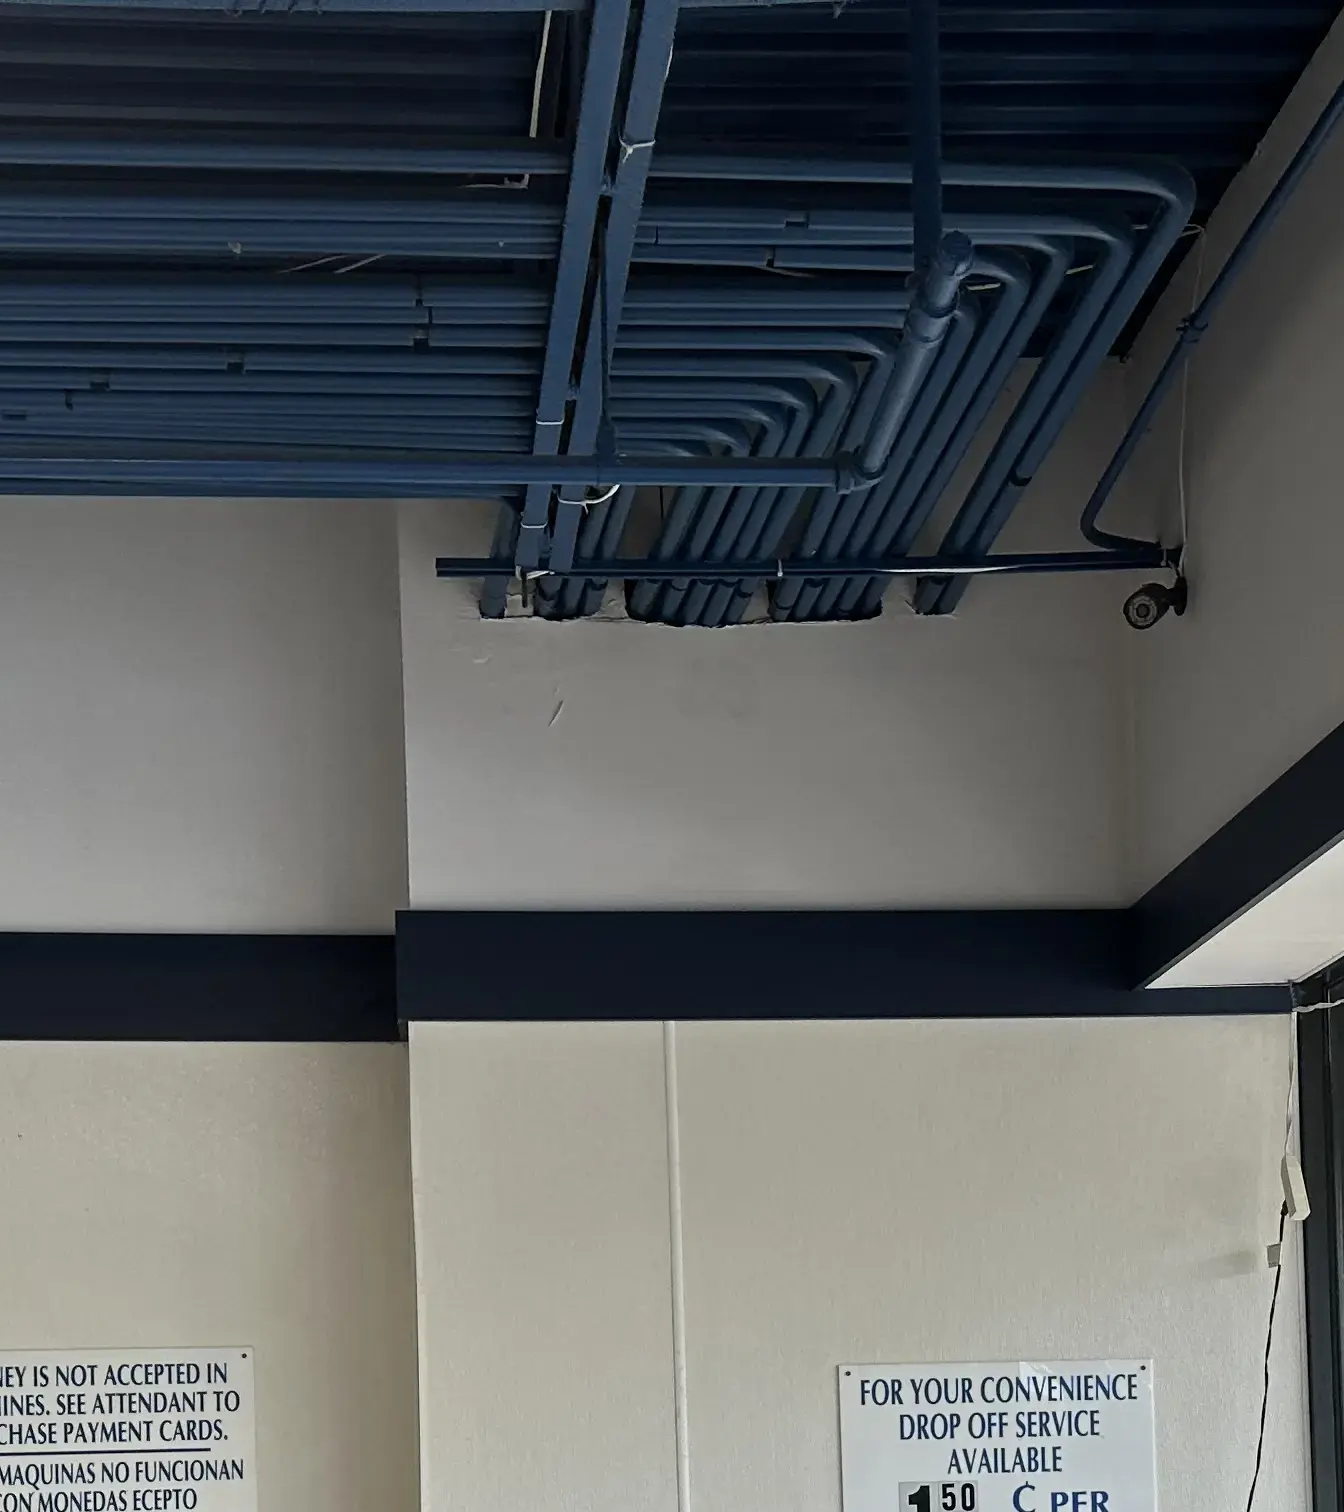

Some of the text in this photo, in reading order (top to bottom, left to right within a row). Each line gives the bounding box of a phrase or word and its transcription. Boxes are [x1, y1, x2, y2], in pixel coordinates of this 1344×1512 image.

[34, 1366, 48, 1387] IS
[56, 1365, 98, 1387] NOT
[104, 1363, 200, 1386] ACCEPTED
[207, 1363, 227, 1384] IN
[860, 1373, 1138, 1406] FOR YOUR CONVENIENCE
[56, 1393, 86, 1415] SEE
[92, 1392, 206, 1414] ATTENDANT
[213, 1391, 240, 1411] TO
[64, 1421, 153, 1443] PAYMENT
[159, 1419, 228, 1441] CARDS.
[899, 1410, 1100, 1440] DROP OFF SERVICE
[102, 1462, 129, 1483] NO
[135, 1459, 244, 1482] FUNCIONAN
[948, 1446, 1062, 1474] AVAILABLE
[38, 1490, 127, 1512] MONEDAS
[133, 1488, 197, 1510] ECEPTO
